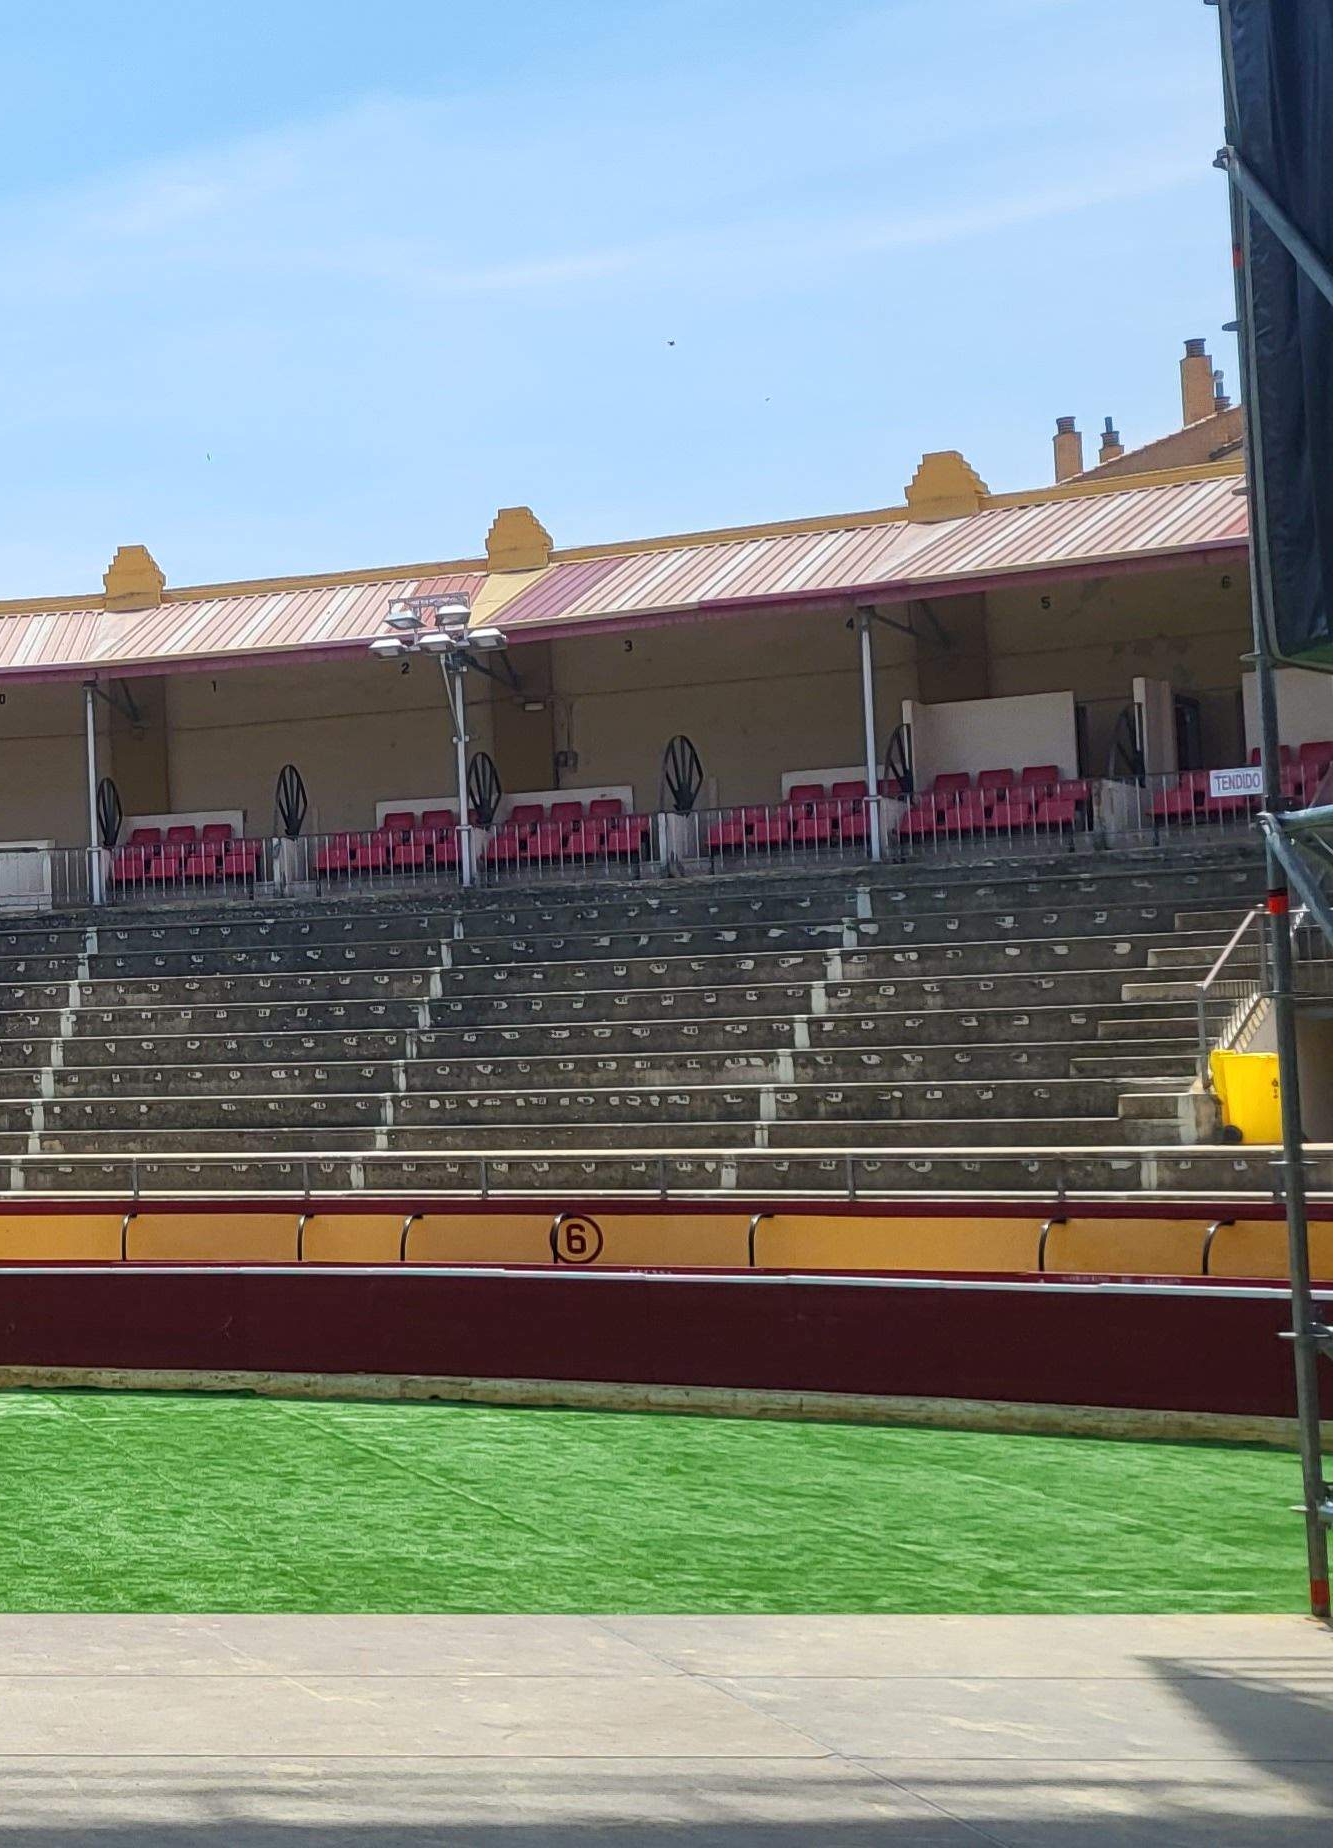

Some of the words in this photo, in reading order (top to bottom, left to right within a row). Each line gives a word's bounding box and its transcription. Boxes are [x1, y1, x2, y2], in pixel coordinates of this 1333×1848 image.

[1041, 596, 1051, 609] 5
[846, 616, 854, 630] 4
[624, 640, 633, 653] 3
[401, 662, 410, 674] 2
[1213, 772, 1261, 791] TENDIDO
[566, 1223, 587, 1255] 6
